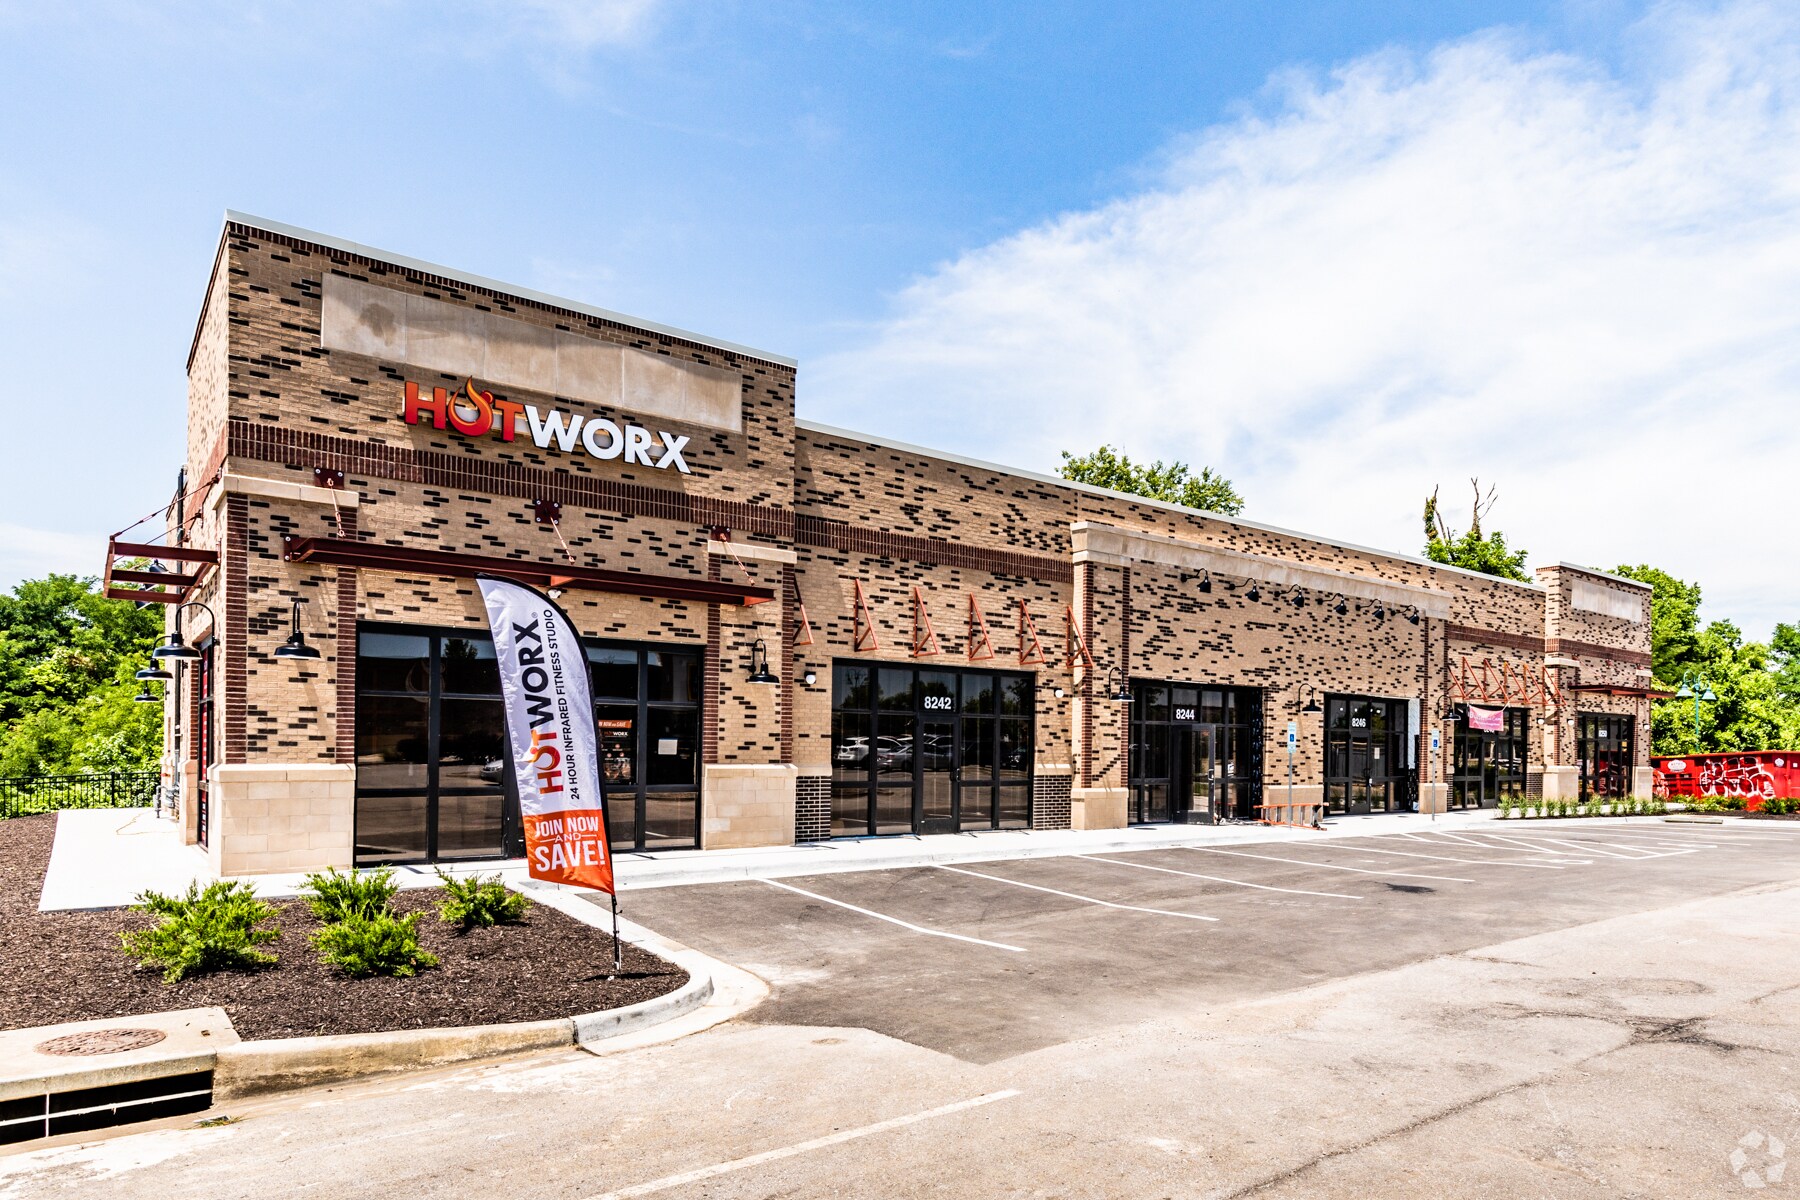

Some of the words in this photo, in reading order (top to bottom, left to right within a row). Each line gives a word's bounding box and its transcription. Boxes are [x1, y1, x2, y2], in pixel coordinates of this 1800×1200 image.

[404, 375, 691, 474] HOTWORX
[543, 609, 558, 650] STUDIO
[550, 652, 566, 695] FITNESS
[512, 618, 564, 794] HOTWORX
[924, 696, 952, 710] 8242
[1175, 708, 1195, 720] 8244
[557, 697, 574, 752] INFRARED
[1351, 717, 1367, 728] 8246
[566, 754, 578, 785] HOUR
[570, 787, 580, 800] 24
[534, 818, 564, 838] JOIN
[566, 816, 599, 833] NOW
[554, 832, 582, 843] AND
[534, 840, 606, 872] SAVE!
